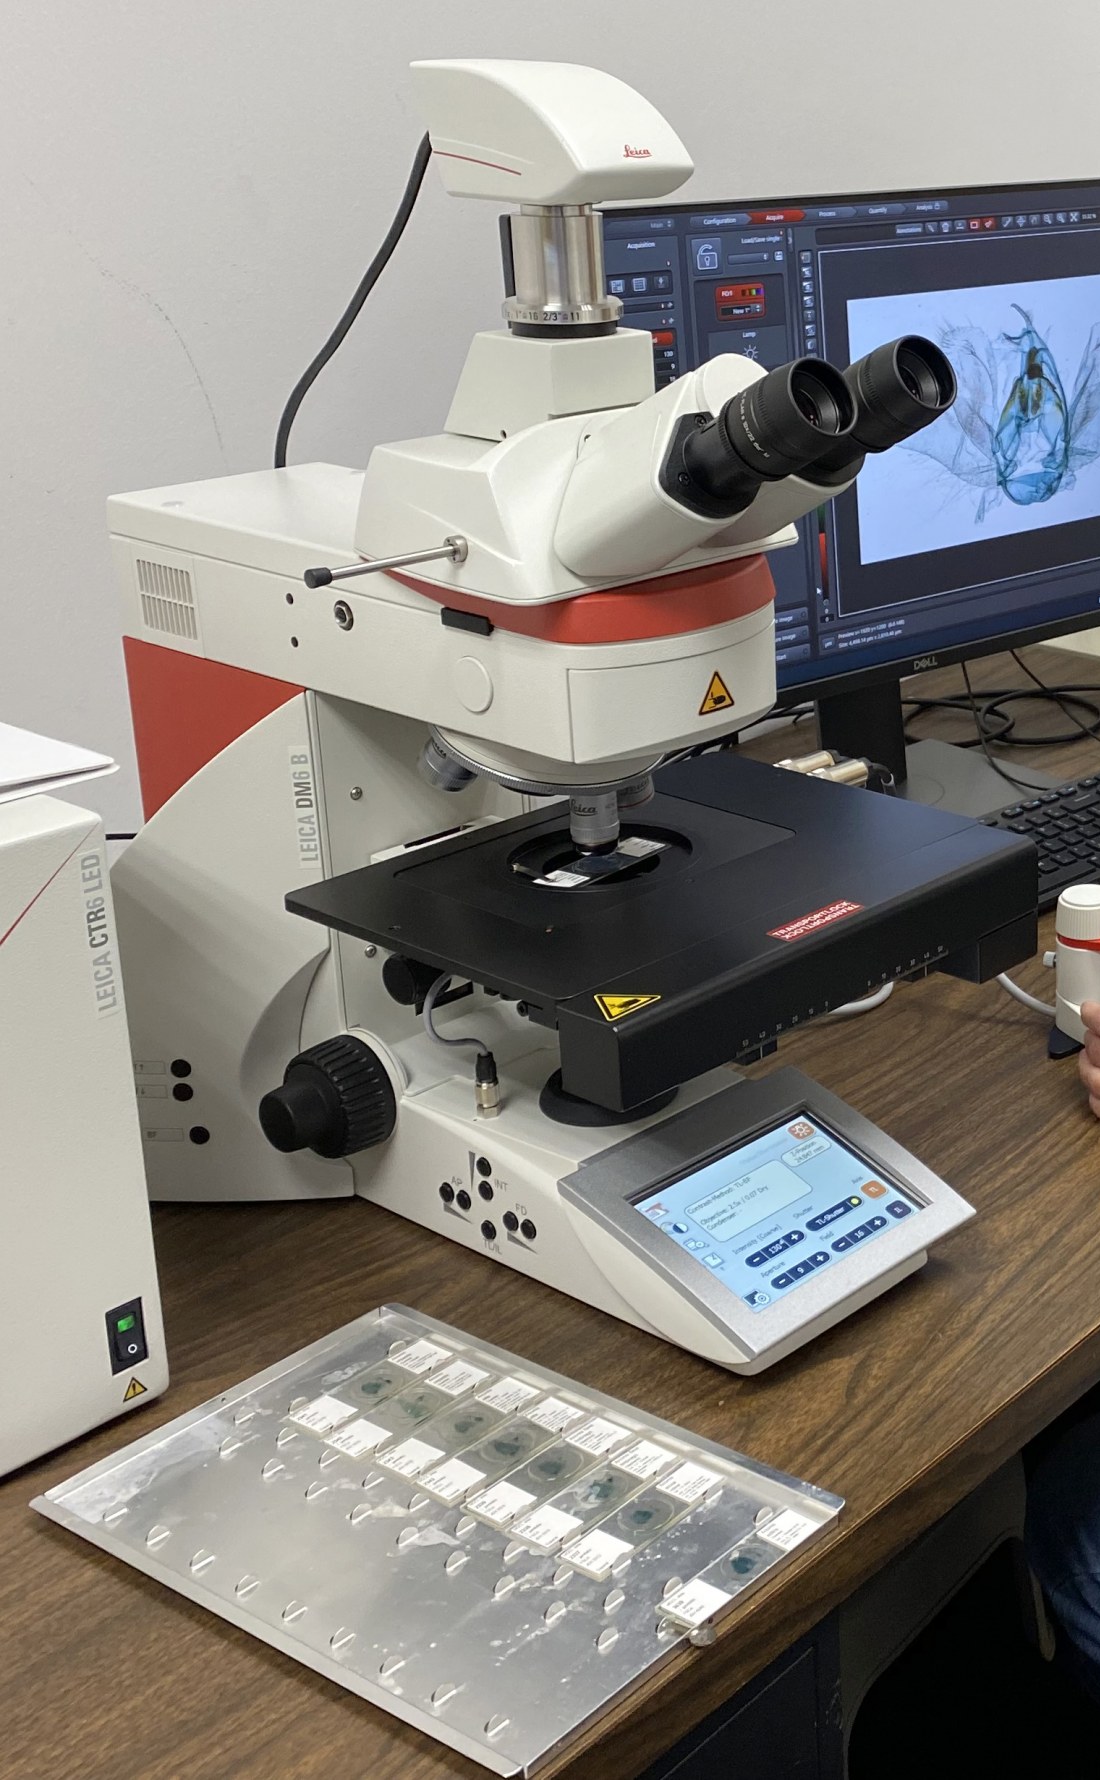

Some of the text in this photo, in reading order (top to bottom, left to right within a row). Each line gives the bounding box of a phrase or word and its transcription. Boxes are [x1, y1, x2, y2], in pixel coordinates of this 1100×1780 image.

[623, 144, 653, 159] Leica
[703, 217, 738, 226] Configuration
[765, 213, 785, 222] Acquire
[627, 241, 656, 250] Acquisition
[913, 656, 938, 670] DELL
[290, 753, 319, 862] LEICA DM6 B
[570, 798, 599, 817] Leica
[80, 853, 118, 1013] LEICA CTR6 LED
[451, 1176, 463, 1186] AP
[494, 1178, 508, 1192] INT
[515, 1203, 528, 1216] FD
[815, 1206, 846, 1226] TL-Shutter
[854, 1229, 865, 1240] 16
[796, 1266, 805, 1275] 9
